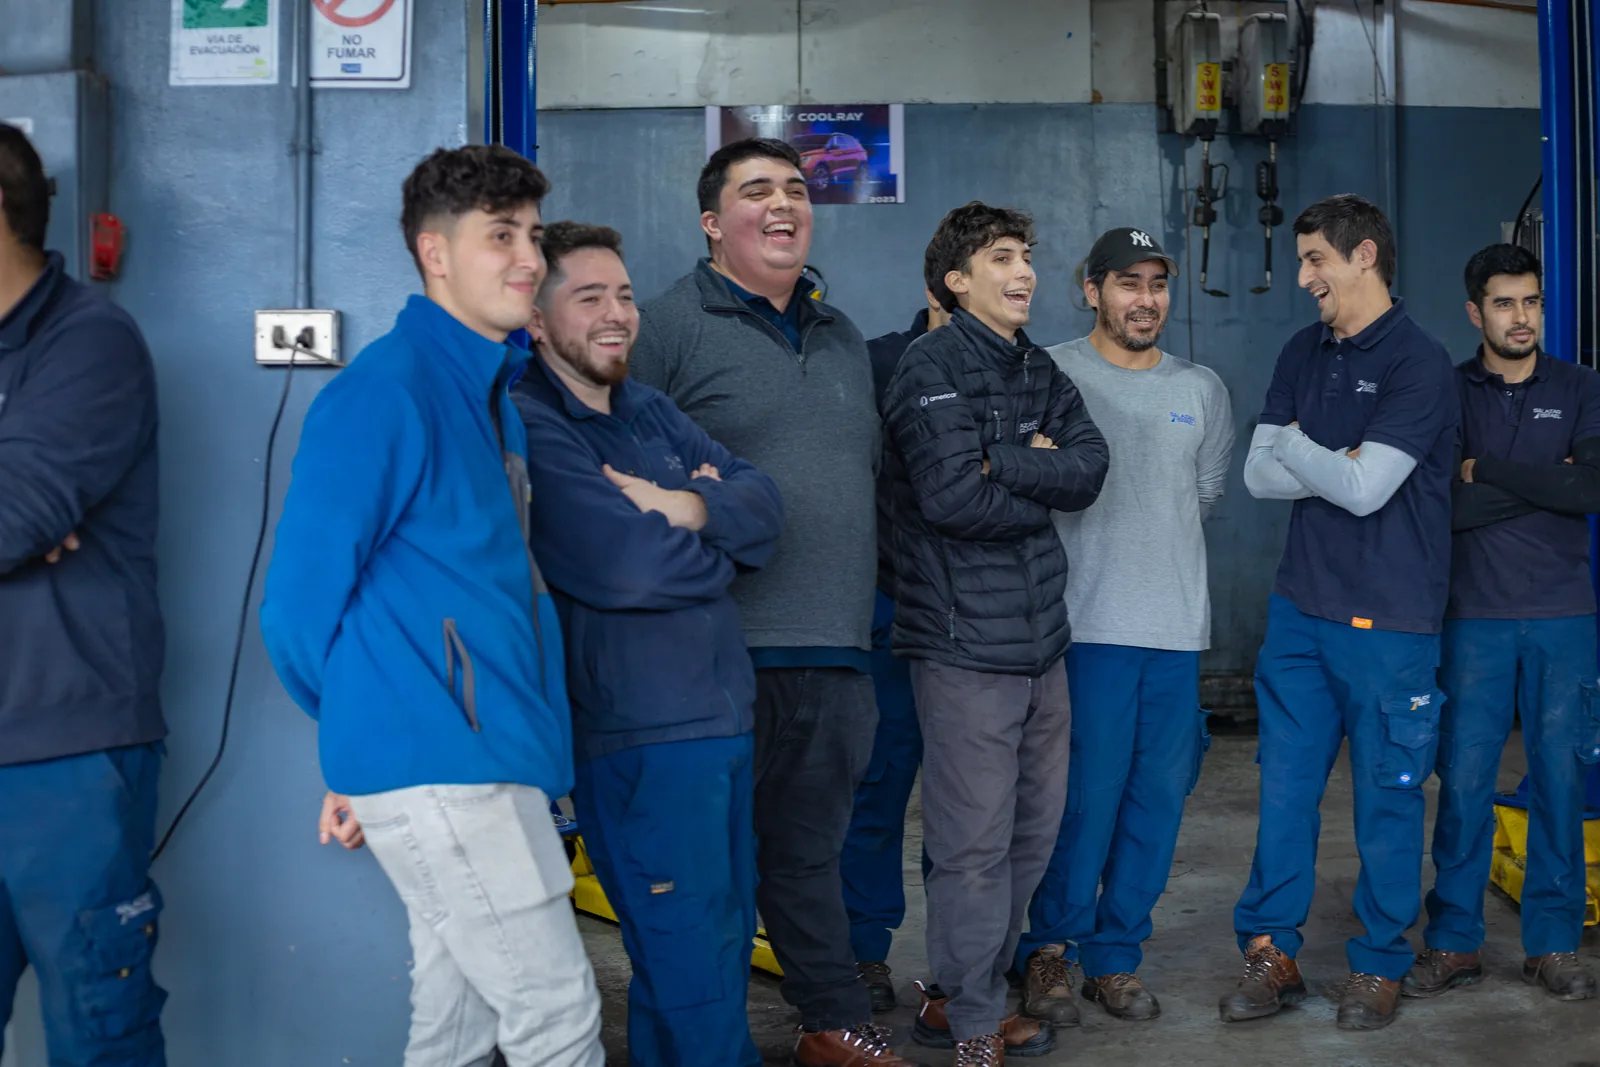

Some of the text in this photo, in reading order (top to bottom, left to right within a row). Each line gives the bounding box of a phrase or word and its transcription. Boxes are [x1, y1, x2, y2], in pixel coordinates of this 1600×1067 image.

[227, 34, 243, 44] DE
[342, 34, 363, 46] NO
[327, 47, 377, 59] FUMAR
[1202, 80, 1215, 91] W
[1269, 80, 1283, 91] W
[1199, 94, 1217, 106] 30
[1267, 94, 1285, 107] 40
[797, 112, 864, 122] COOLRAY
[869, 195, 897, 204] 2023
